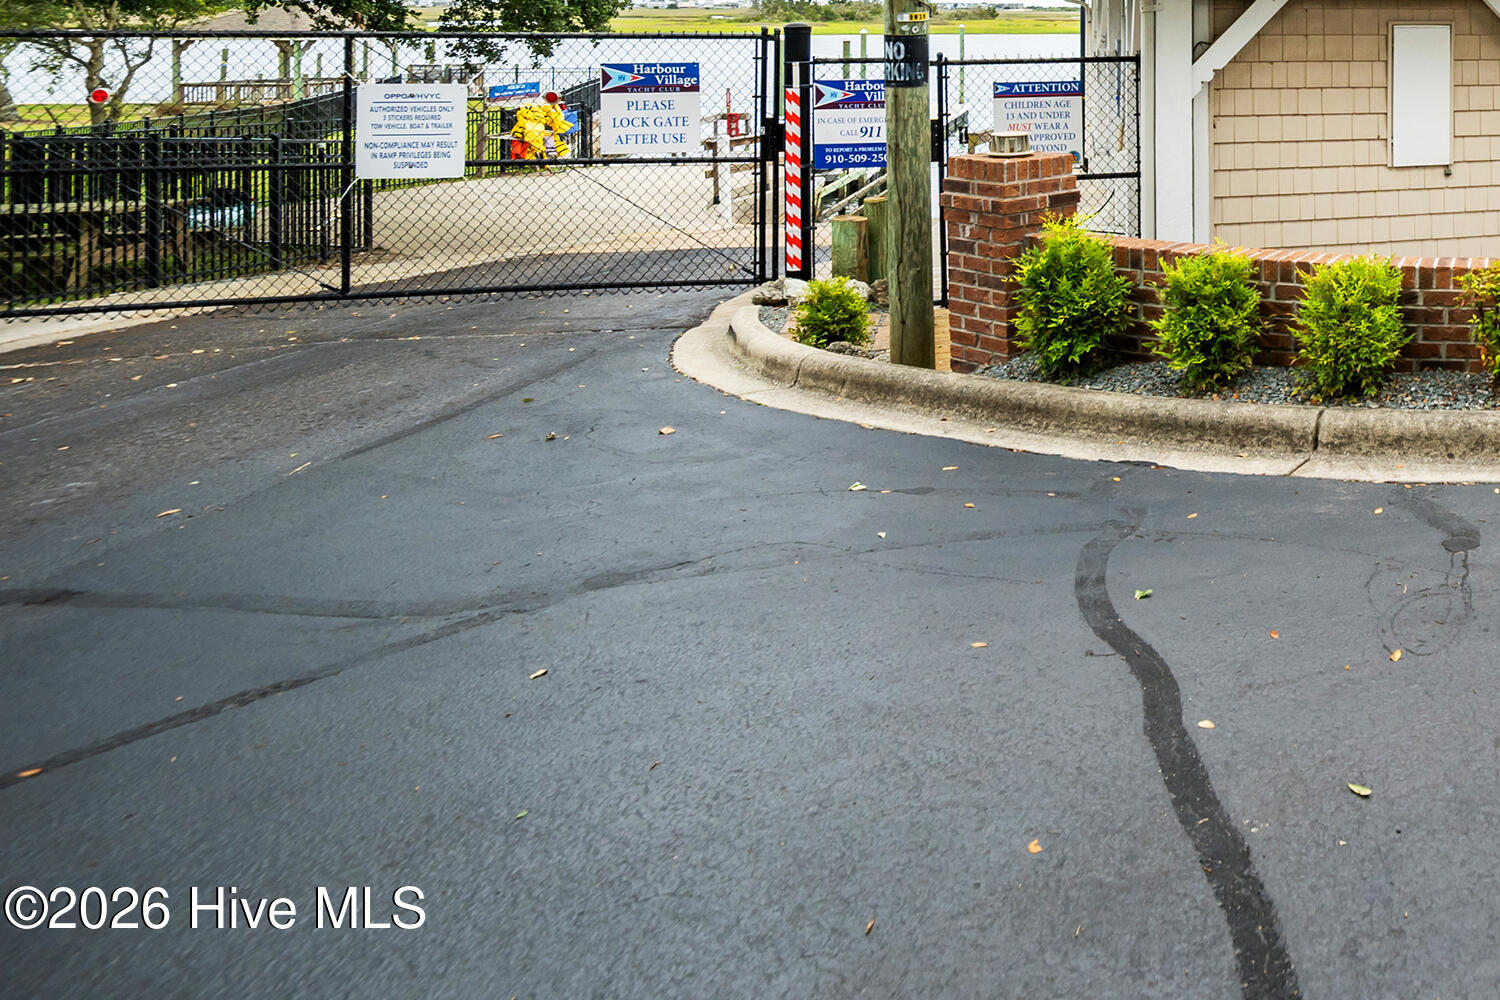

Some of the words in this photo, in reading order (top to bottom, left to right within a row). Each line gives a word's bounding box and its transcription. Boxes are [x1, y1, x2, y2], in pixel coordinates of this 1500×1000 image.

[885, 41, 905, 60] NO
[633, 64, 686, 74] Harbour
[655, 75, 697, 87] Village
[1012, 83, 1079, 93] ATTENTION
[627, 100, 675, 111] PLEASE
[1004, 101, 1051, 109] CHILDREN
[1053, 100, 1072, 108] AGE
[1017, 112, 1037, 120] AND
[1039, 111, 1071, 119] UNDER
[612, 117, 650, 128] LOCK
[653, 116, 689, 127] GATE
[1008, 123, 1033, 131] MUST
[860, 126, 881, 138] 911
[615, 134, 658, 144] AFTER
[662, 133, 687, 144] USE
[364, 141, 419, 149] NON-COMPLIANCE
[1030, 144, 1067, 152] BEYOND
